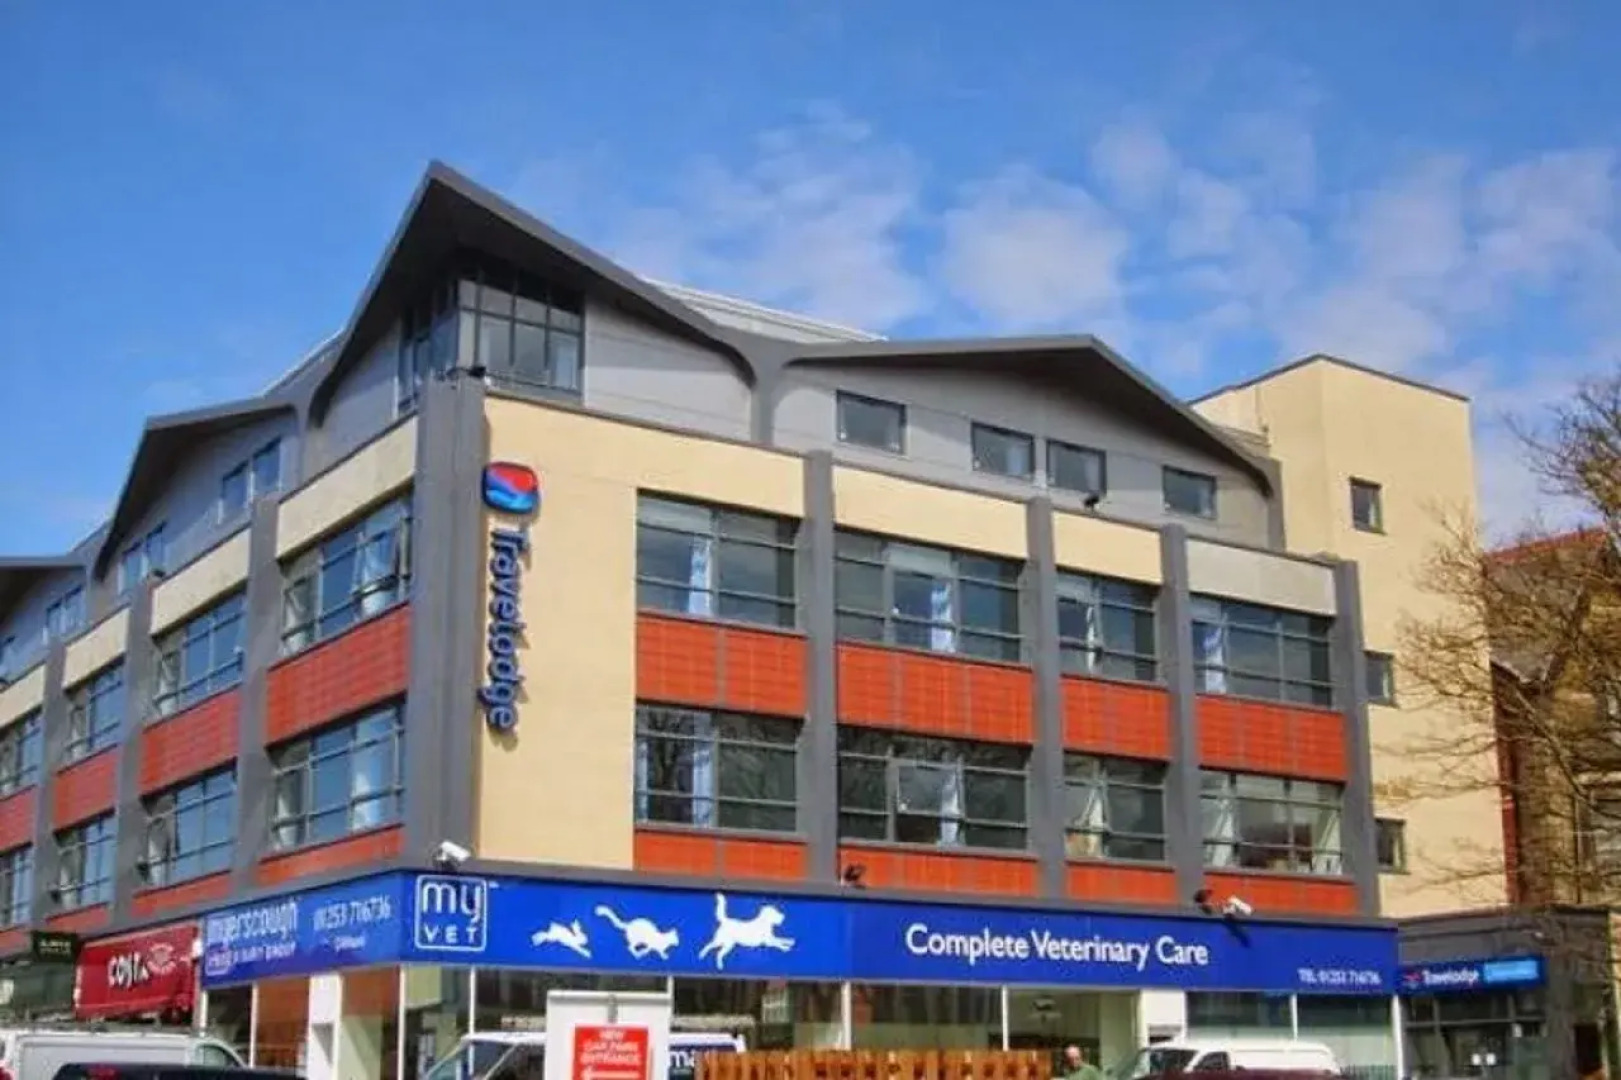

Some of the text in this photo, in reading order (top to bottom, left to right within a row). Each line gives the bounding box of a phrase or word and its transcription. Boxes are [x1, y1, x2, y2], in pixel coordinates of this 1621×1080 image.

[422, 882, 482, 924] my
[423, 922, 478, 944] VET
[905, 922, 1209, 972] Complete Veterinary Care
